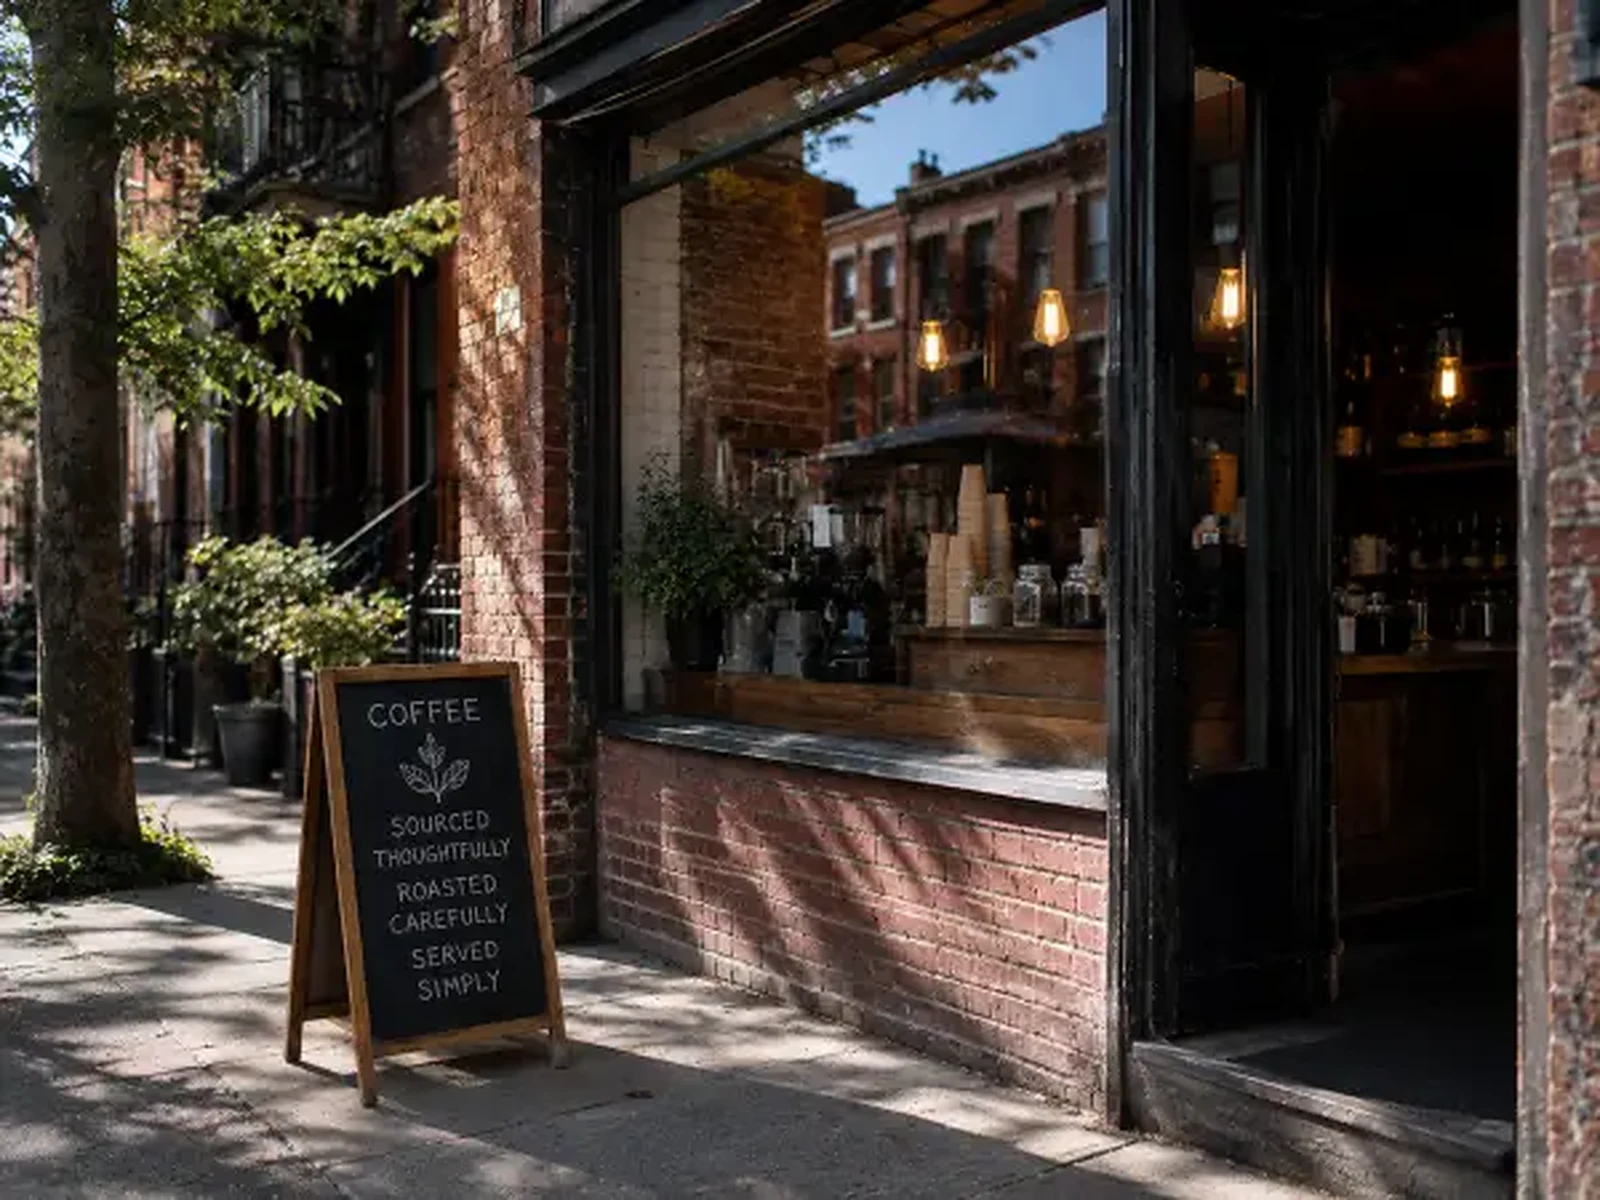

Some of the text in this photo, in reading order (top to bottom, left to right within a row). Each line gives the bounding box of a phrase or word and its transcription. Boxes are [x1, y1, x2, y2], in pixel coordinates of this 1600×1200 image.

[368, 698, 481, 728] COFFEE
[390, 810, 490, 838] SOURCED
[373, 838, 511, 868] THOUGHTFULLY
[396, 874, 497, 902] ROASTED
[389, 903, 508, 934] CAREFULLY
[412, 940, 500, 969] SERVED
[418, 969, 501, 1001] SIMPLY
